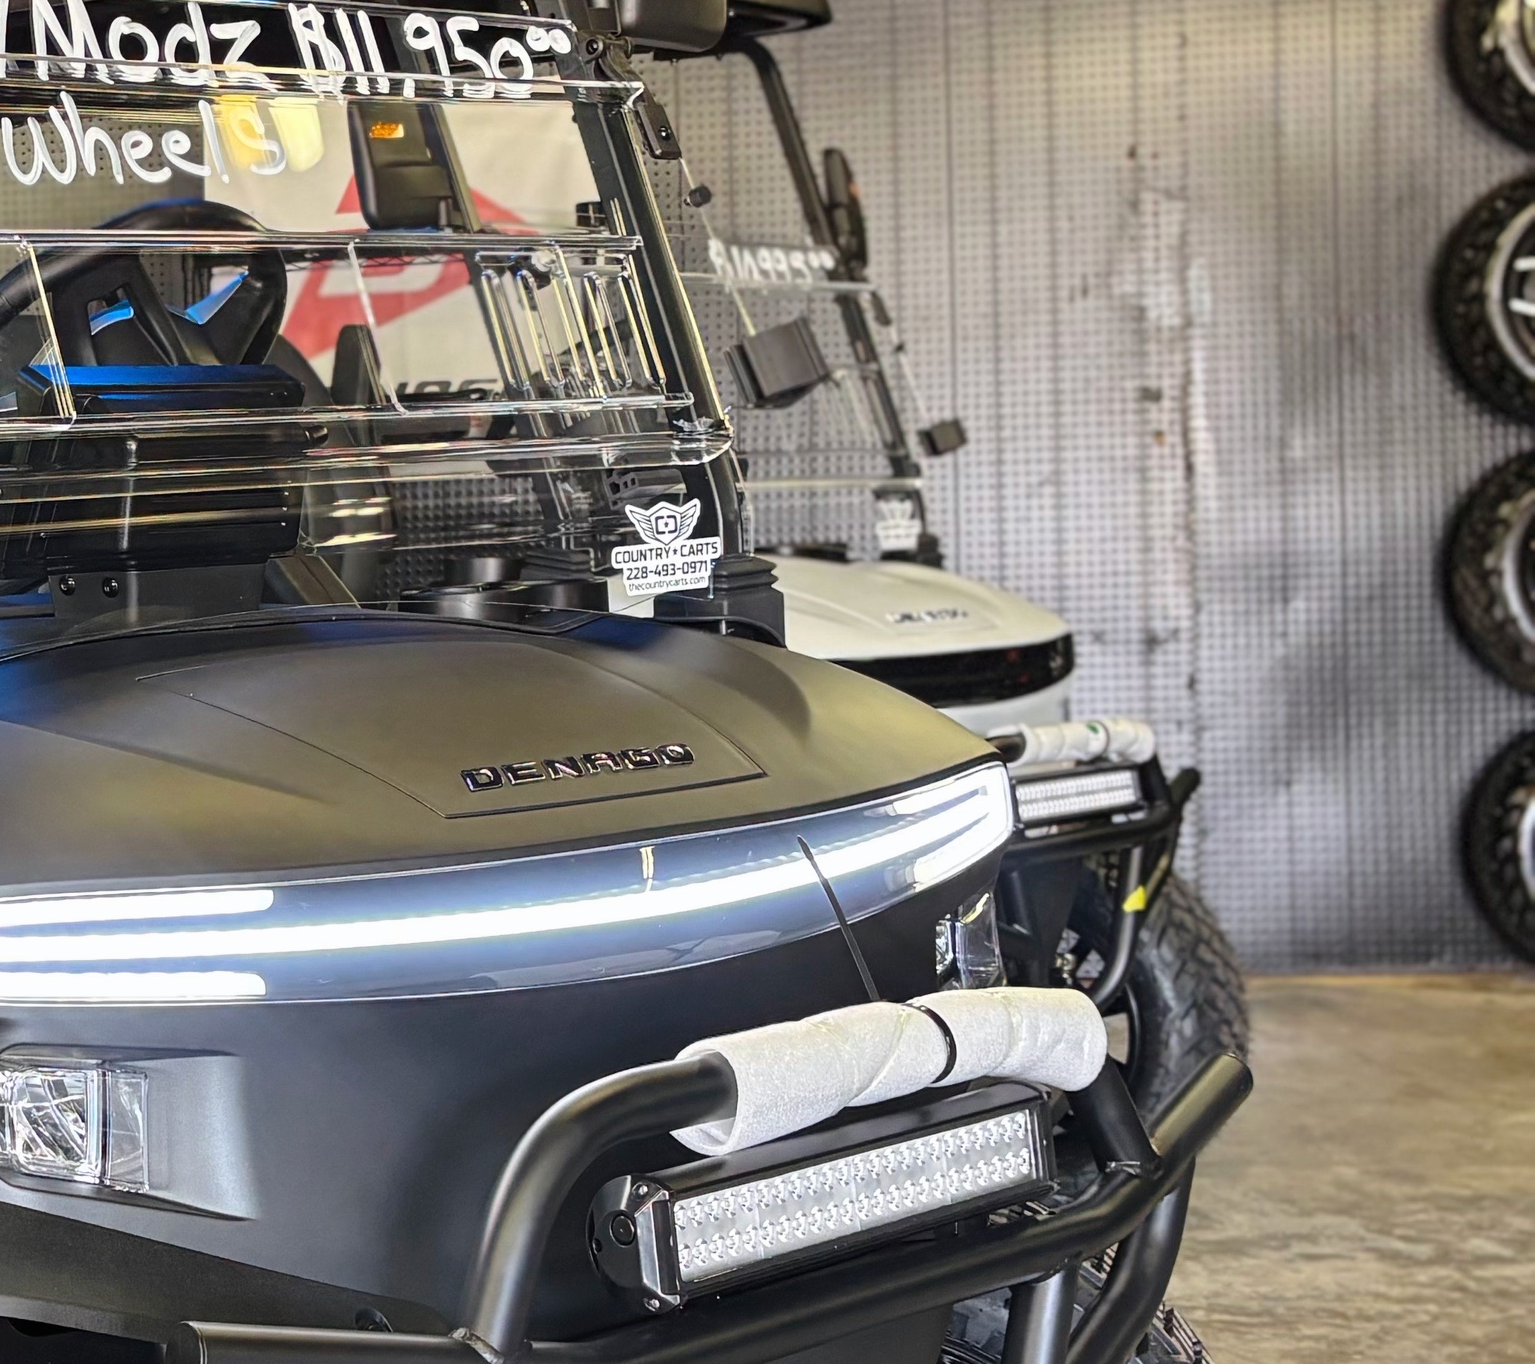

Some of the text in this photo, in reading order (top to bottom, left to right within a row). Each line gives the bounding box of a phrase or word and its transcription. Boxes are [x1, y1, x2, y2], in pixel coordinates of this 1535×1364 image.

[1, 92, 287, 184] Wheels
[614, 542, 718, 564] COUNTRY CARTS
[626, 560, 708, 581] 228-493-0971
[460, 742, 696, 793] DENAGO
